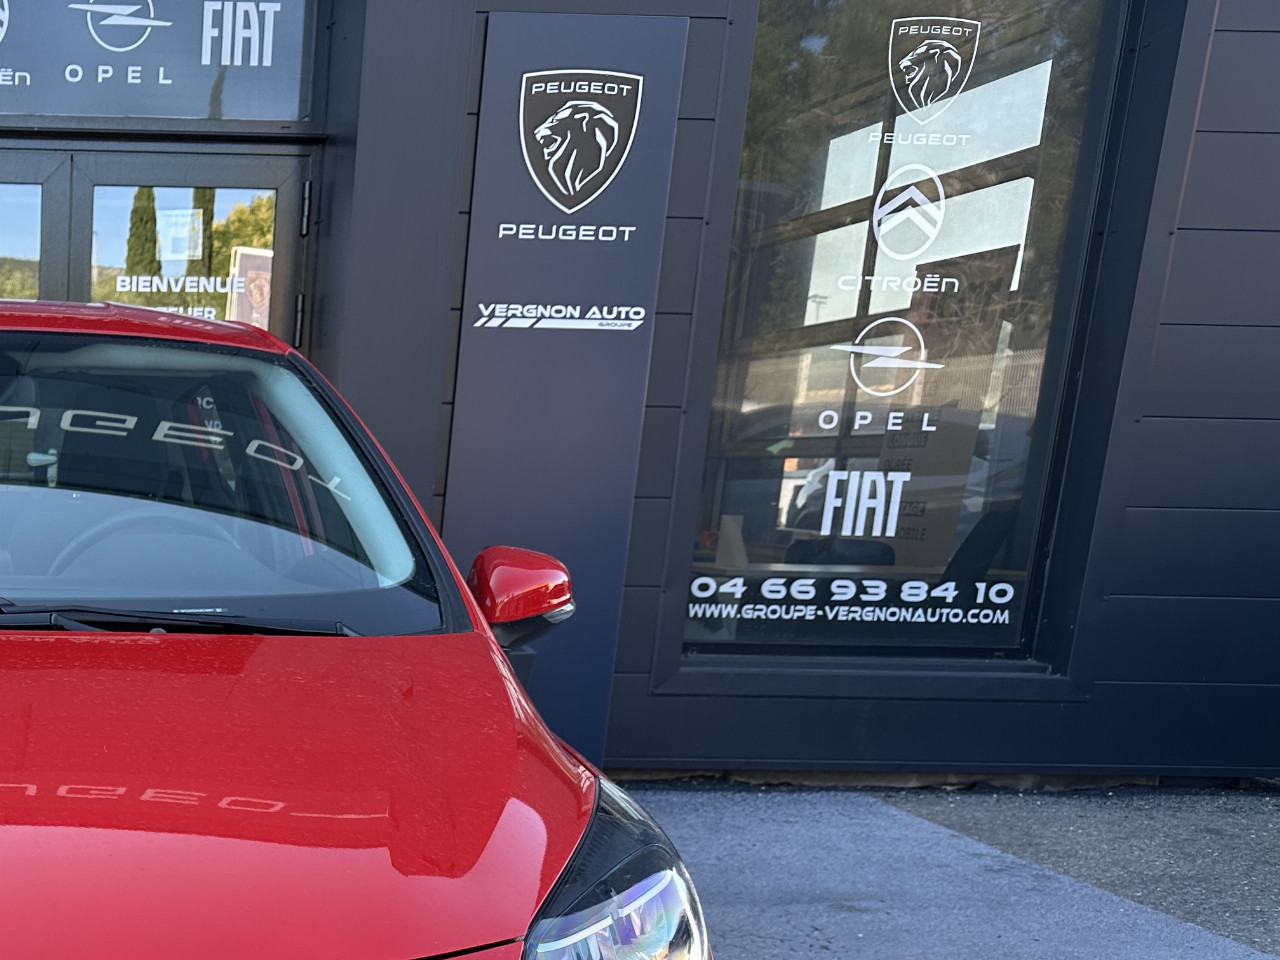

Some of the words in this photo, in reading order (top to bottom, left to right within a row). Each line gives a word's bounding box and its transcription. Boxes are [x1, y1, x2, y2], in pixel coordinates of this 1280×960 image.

[201, 0, 281, 67] FIAT
[898, 25, 973, 37] PEUGEOT
[531, 81, 632, 97] PEUGEOT
[868, 132, 972, 146] PEUGEOT
[498, 223, 637, 242] PEUGEOT
[115, 276, 246, 293] BIENVENUE
[478, 303, 581, 319] VERGNON
[585, 305, 646, 320] AUTO
[820, 471, 911, 537] FIAT
[690, 576, 748, 598] 04
[761, 578, 816, 600] 66
[830, 579, 887, 601] 93
[900, 580, 958, 602] 84
[976, 582, 1015, 604] 10
[688, 603, 1009, 624] WWW.GROUPE-VERGNONAUTO.COM
